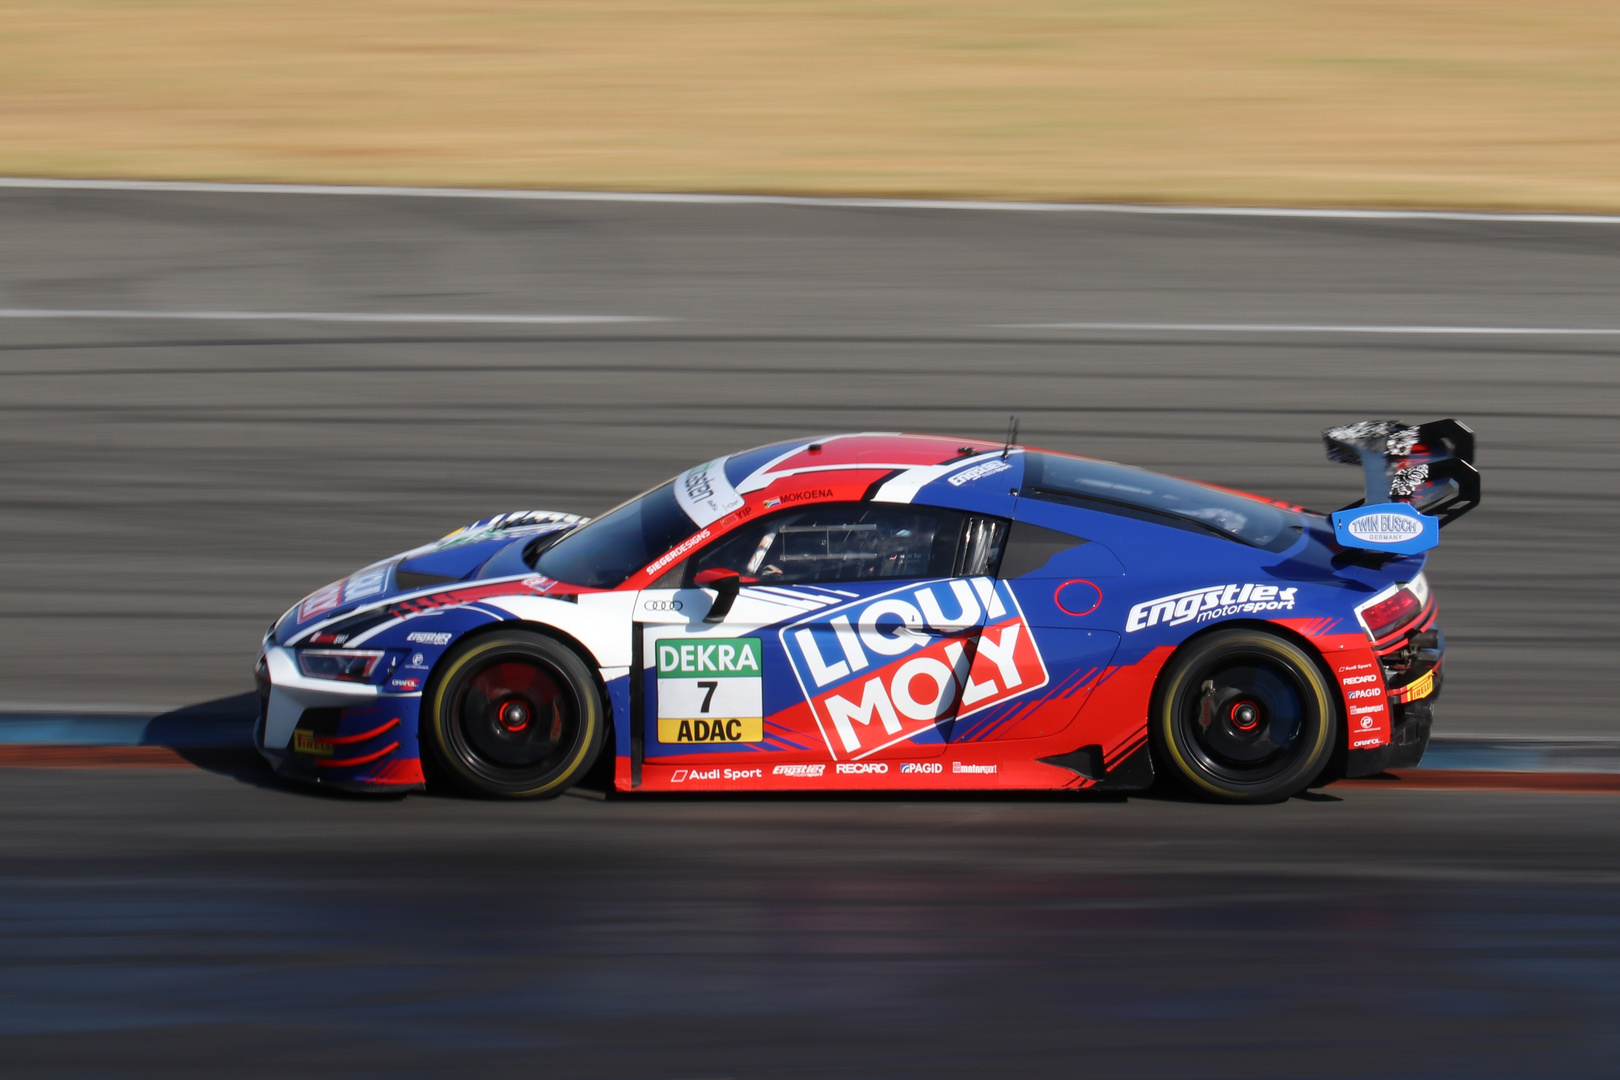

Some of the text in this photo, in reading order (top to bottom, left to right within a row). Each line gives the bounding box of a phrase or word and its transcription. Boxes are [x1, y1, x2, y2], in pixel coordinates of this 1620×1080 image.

[780, 489, 834, 504] MOKOENA
[735, 506, 752, 519] YIP
[1352, 514, 1417, 532] TWIN BUSCH
[646, 528, 711, 576] SIEGERDESIGNS
[1125, 583, 1298, 633] Engstler
[1196, 600, 1296, 623] motorsport
[794, 576, 1007, 688] LIQUI
[660, 644, 759, 672] DEKRA
[824, 623, 1021, 753] MOLY
[1343, 674, 1377, 685] RECARO
[697, 681, 718, 713] 7
[1355, 687, 1381, 699] PAGID
[677, 719, 742, 741] ADAC
[689, 768, 762, 781] Audi Sport
[772, 764, 826, 777] Engstler
[836, 763, 889, 774] RECARO
[909, 763, 943, 774] PAGID
